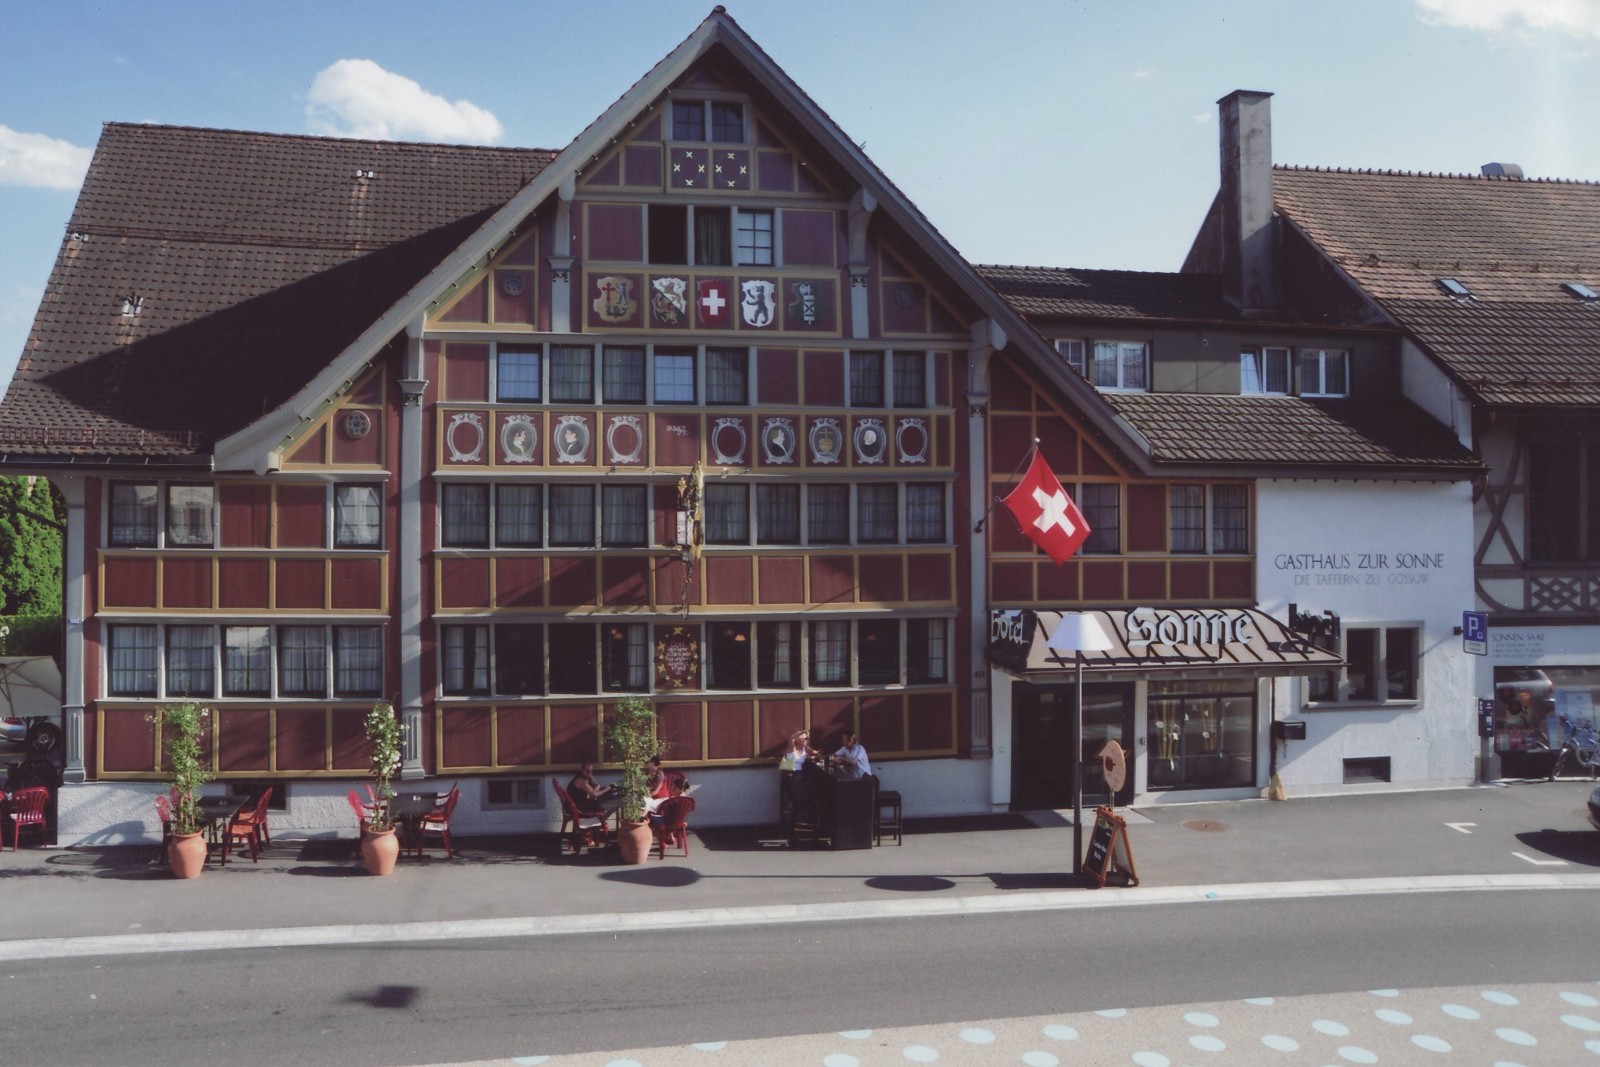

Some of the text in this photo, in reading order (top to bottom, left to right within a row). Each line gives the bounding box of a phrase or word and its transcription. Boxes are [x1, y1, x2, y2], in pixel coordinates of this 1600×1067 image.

[1274, 553, 1444, 570] GASTHAUS ZUR SONNE
[1294, 574, 1310, 586] DIE
[1364, 573, 1380, 585] ZU
[1126, 606, 1253, 647] Sonne
[1468, 616, 1479, 637] P
